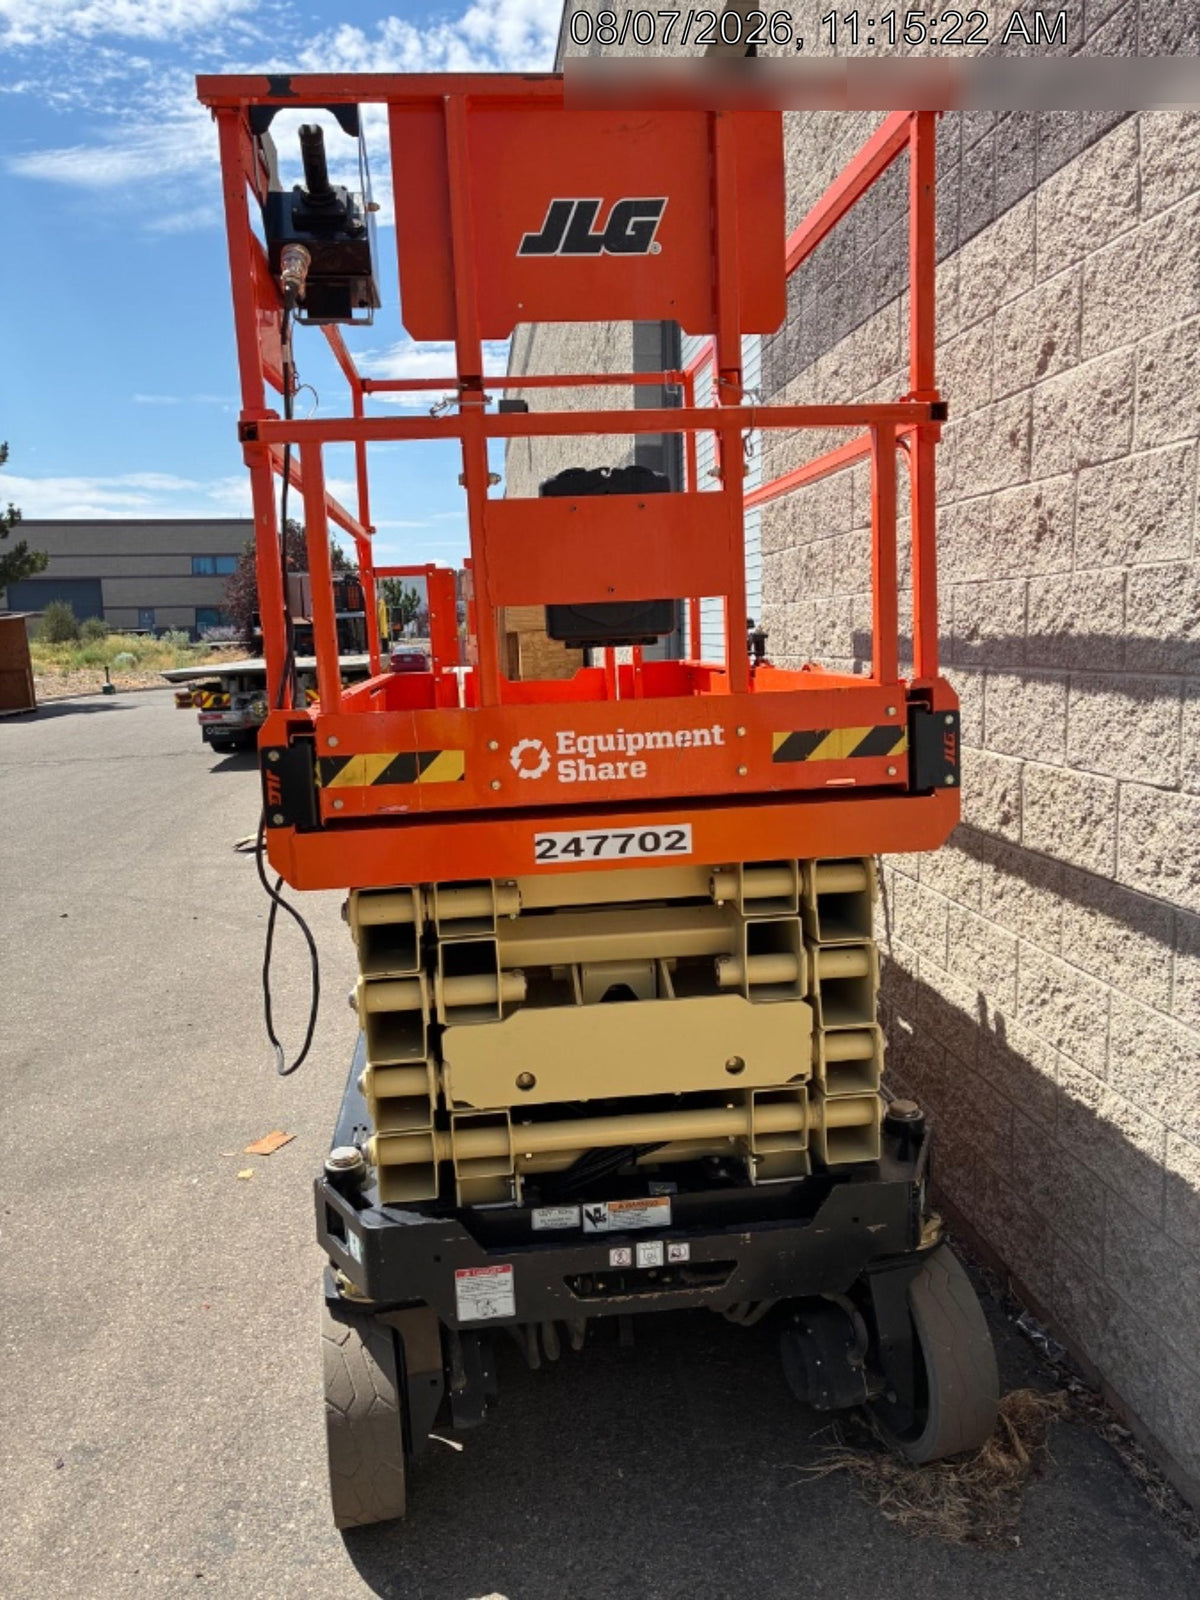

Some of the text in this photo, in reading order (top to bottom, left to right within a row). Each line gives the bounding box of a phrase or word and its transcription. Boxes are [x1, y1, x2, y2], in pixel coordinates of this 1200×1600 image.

[516, 197, 669, 257] JLG
[556, 724, 725, 758] Equipment
[944, 732, 957, 766] JLG
[265, 769, 282, 806] JLG
[556, 759, 648, 783] Share
[535, 829, 687, 860] 247702
